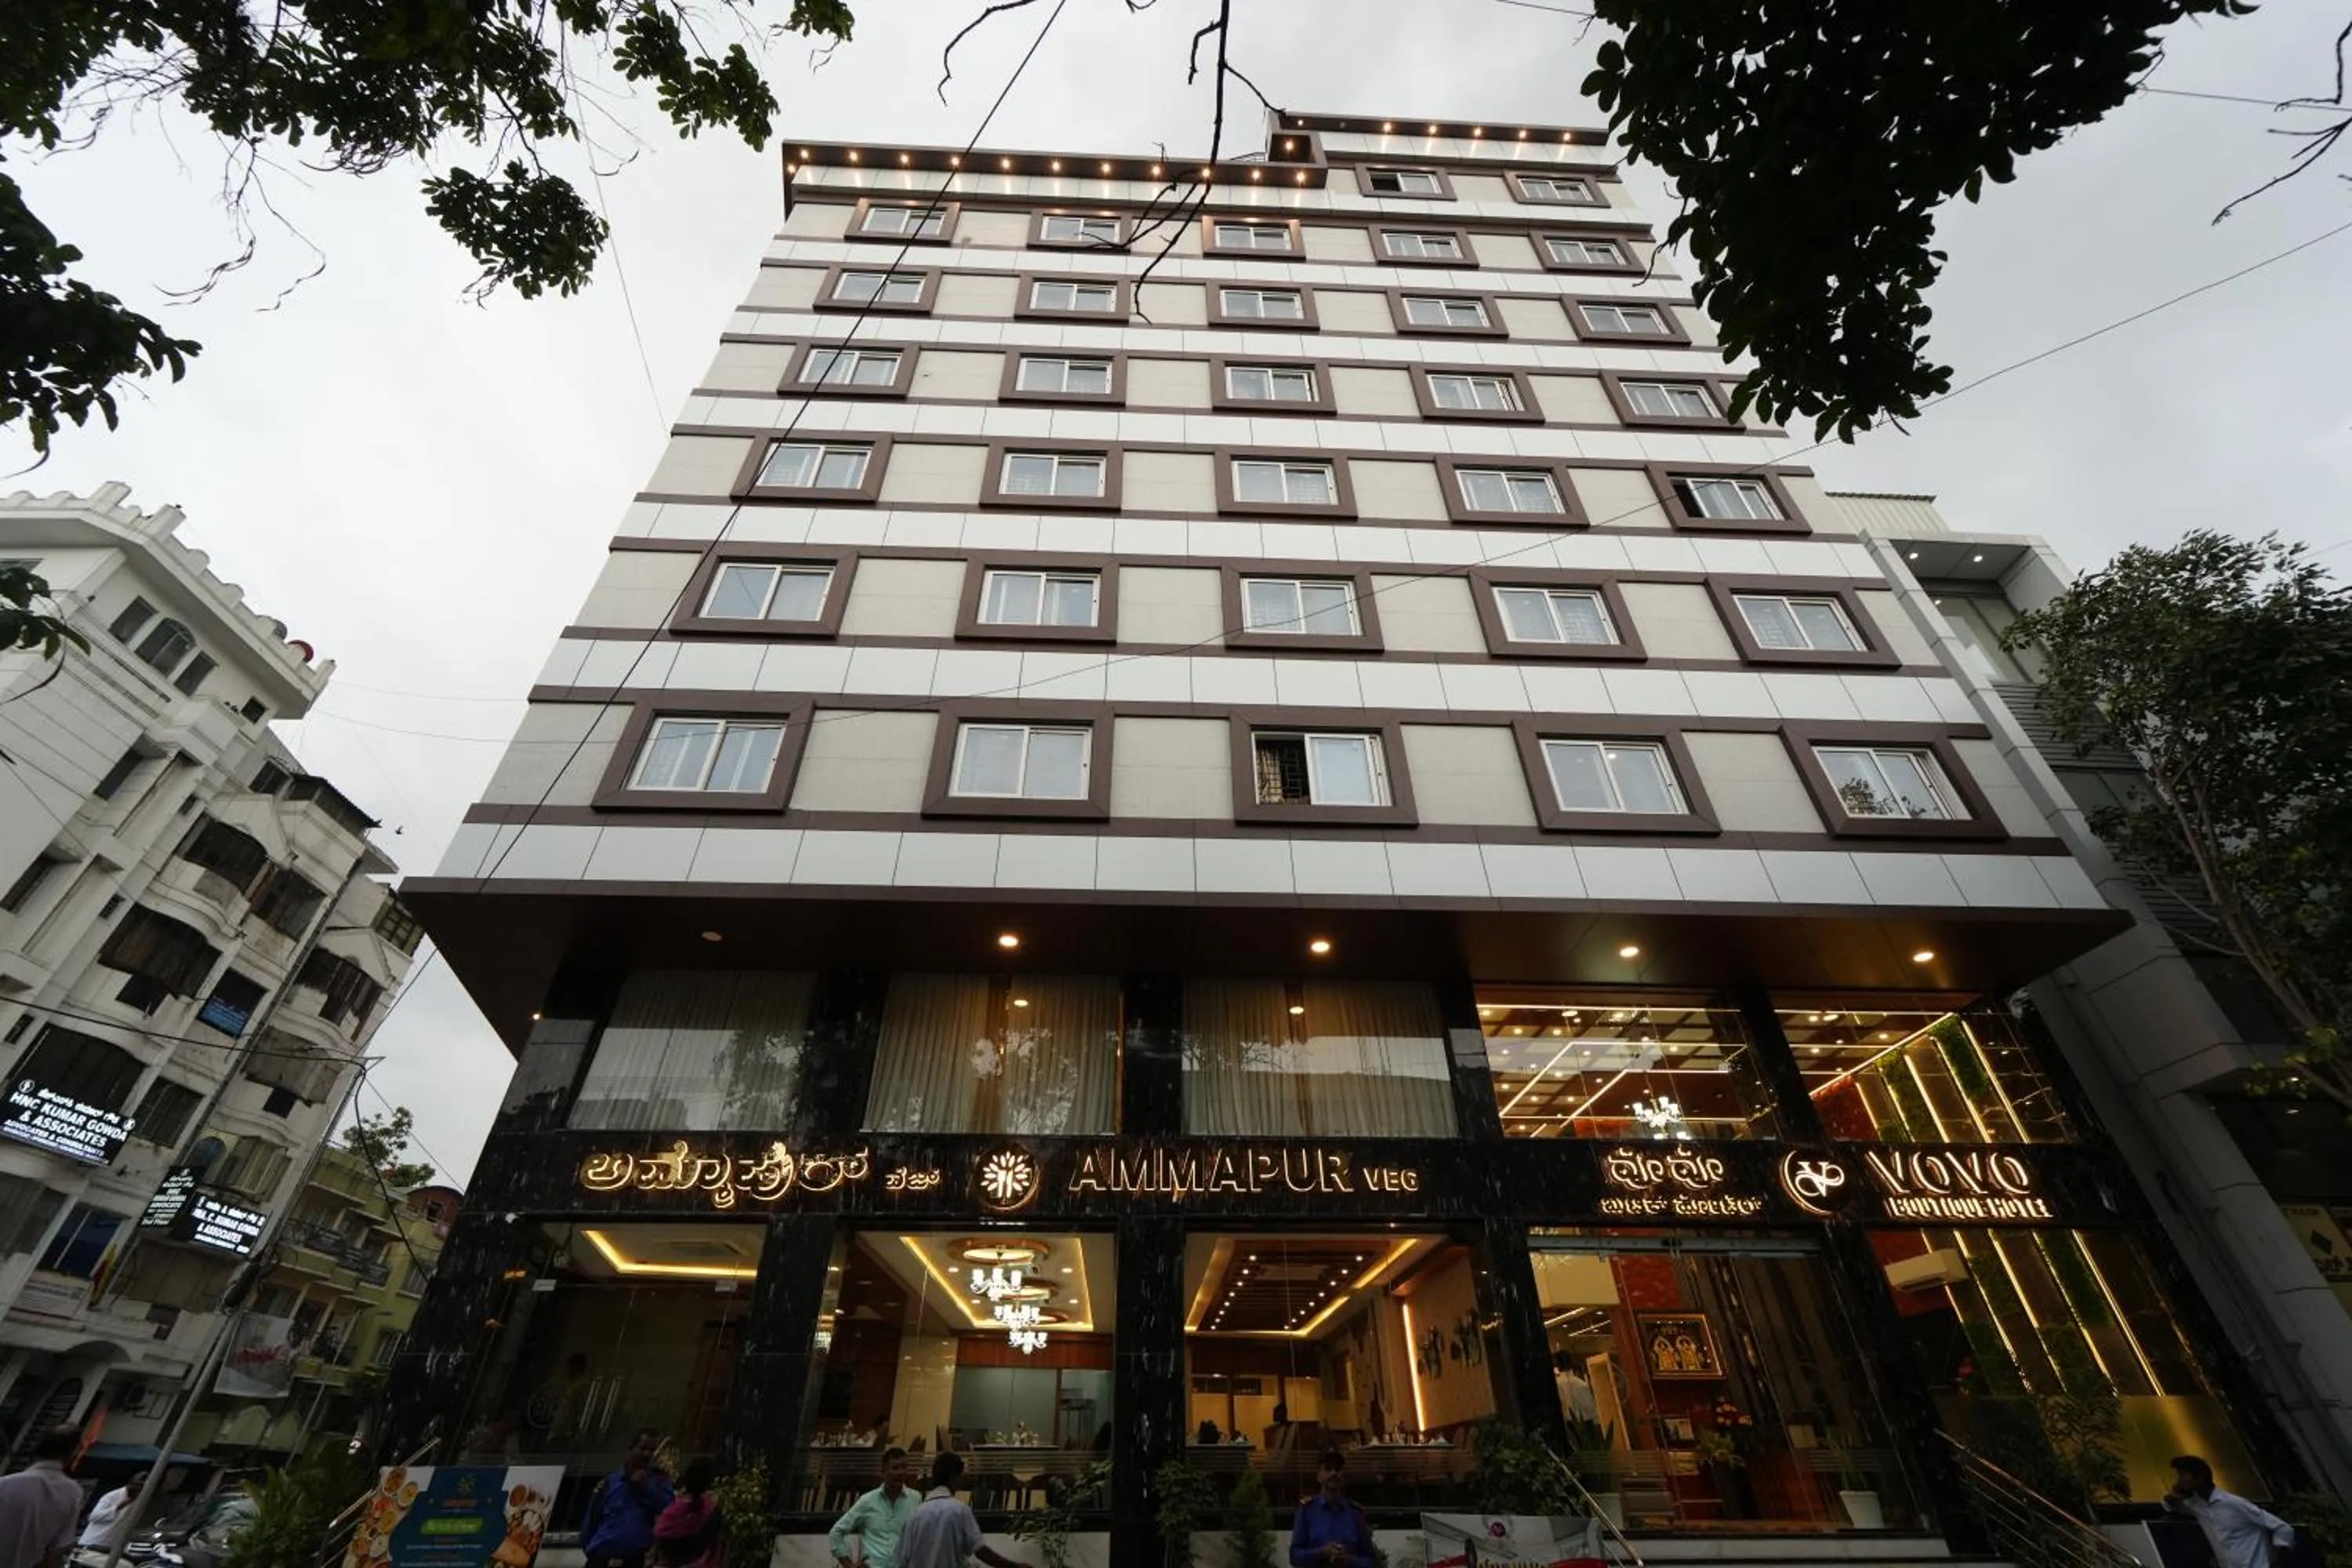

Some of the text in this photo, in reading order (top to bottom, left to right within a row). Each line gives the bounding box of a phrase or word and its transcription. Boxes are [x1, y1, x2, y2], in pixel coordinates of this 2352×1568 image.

[9, 1091, 41, 1109] HNC
[41, 1102, 86, 1126] KUMAR
[86, 1119, 128, 1142] GOWDA
[20, 1110, 31, 1122] &
[31, 1116, 107, 1147] ASSOCIATES
[1069, 1148, 1419, 1192] AMMAPUR VEG
[1865, 1151, 2031, 1194] VOVO
[1886, 1197, 2053, 1218] BOUTIQUE HOTEL
